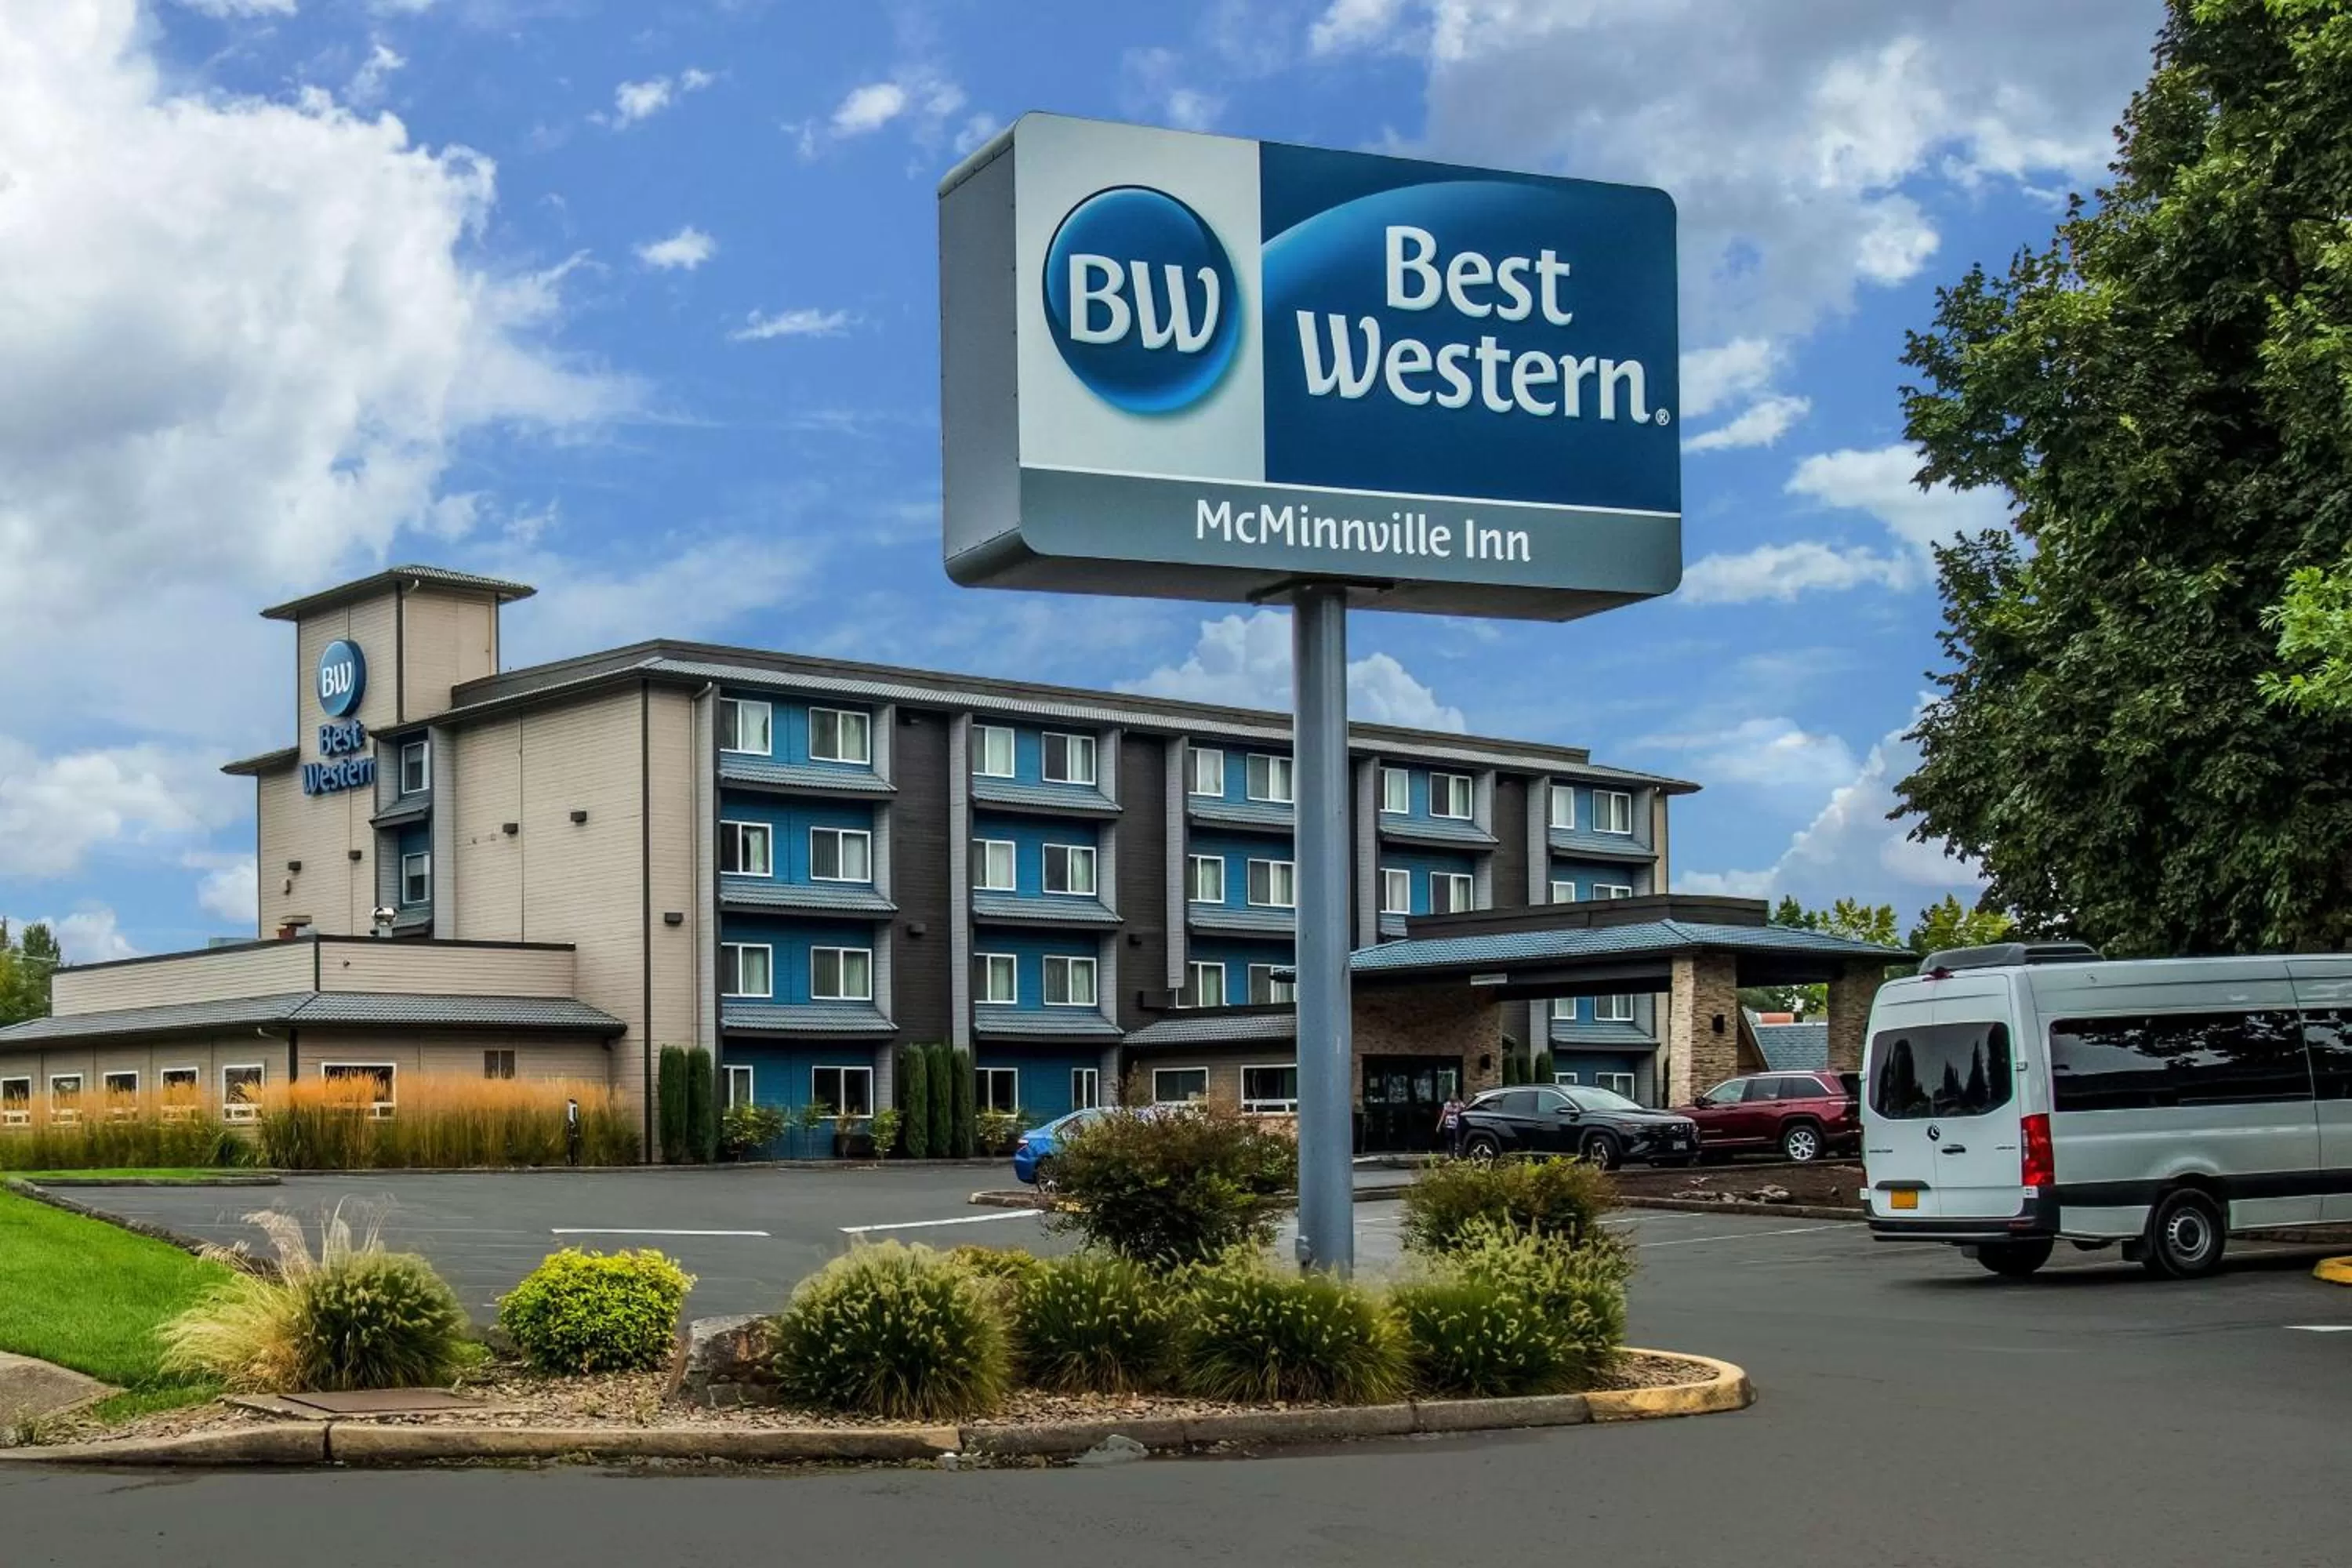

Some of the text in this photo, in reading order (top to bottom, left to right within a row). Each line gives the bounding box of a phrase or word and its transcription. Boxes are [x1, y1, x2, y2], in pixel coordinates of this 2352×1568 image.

[1385, 225, 1573, 326] Best
[1069, 253, 1221, 353] BW
[1196, 499, 1531, 562] McMinnville Inn
[322, 662, 352, 698] BW
[319, 720, 363, 756] Best
[303, 757, 376, 795] Western
